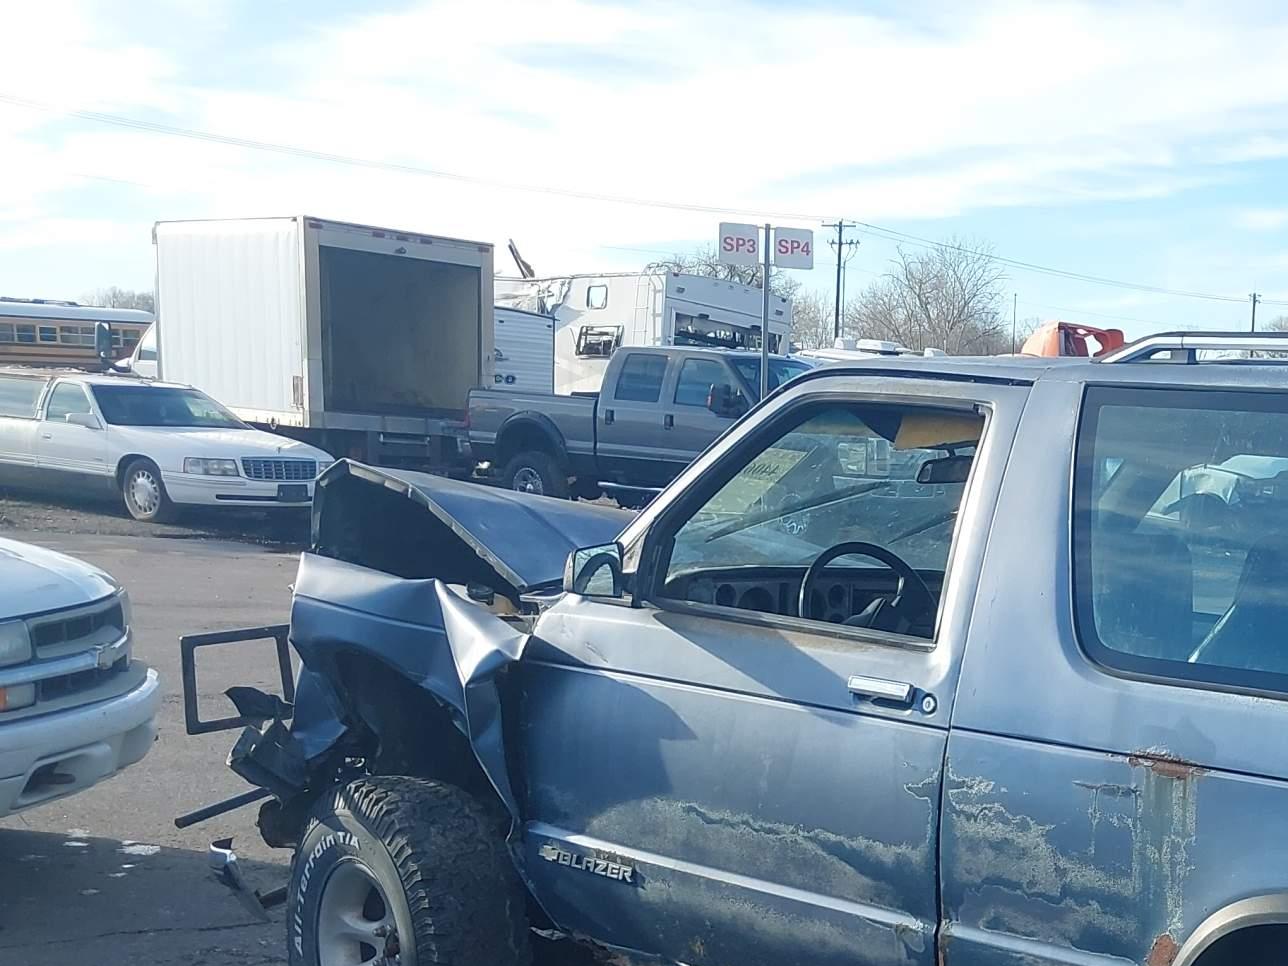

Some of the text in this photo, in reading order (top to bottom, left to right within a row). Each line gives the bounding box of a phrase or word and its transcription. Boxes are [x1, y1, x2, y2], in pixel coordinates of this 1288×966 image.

[722, 236, 756, 254] SP3
[778, 238, 812, 256] SP4
[558, 850, 633, 883] BLAZER
[294, 833, 335, 957] All-Terrain
